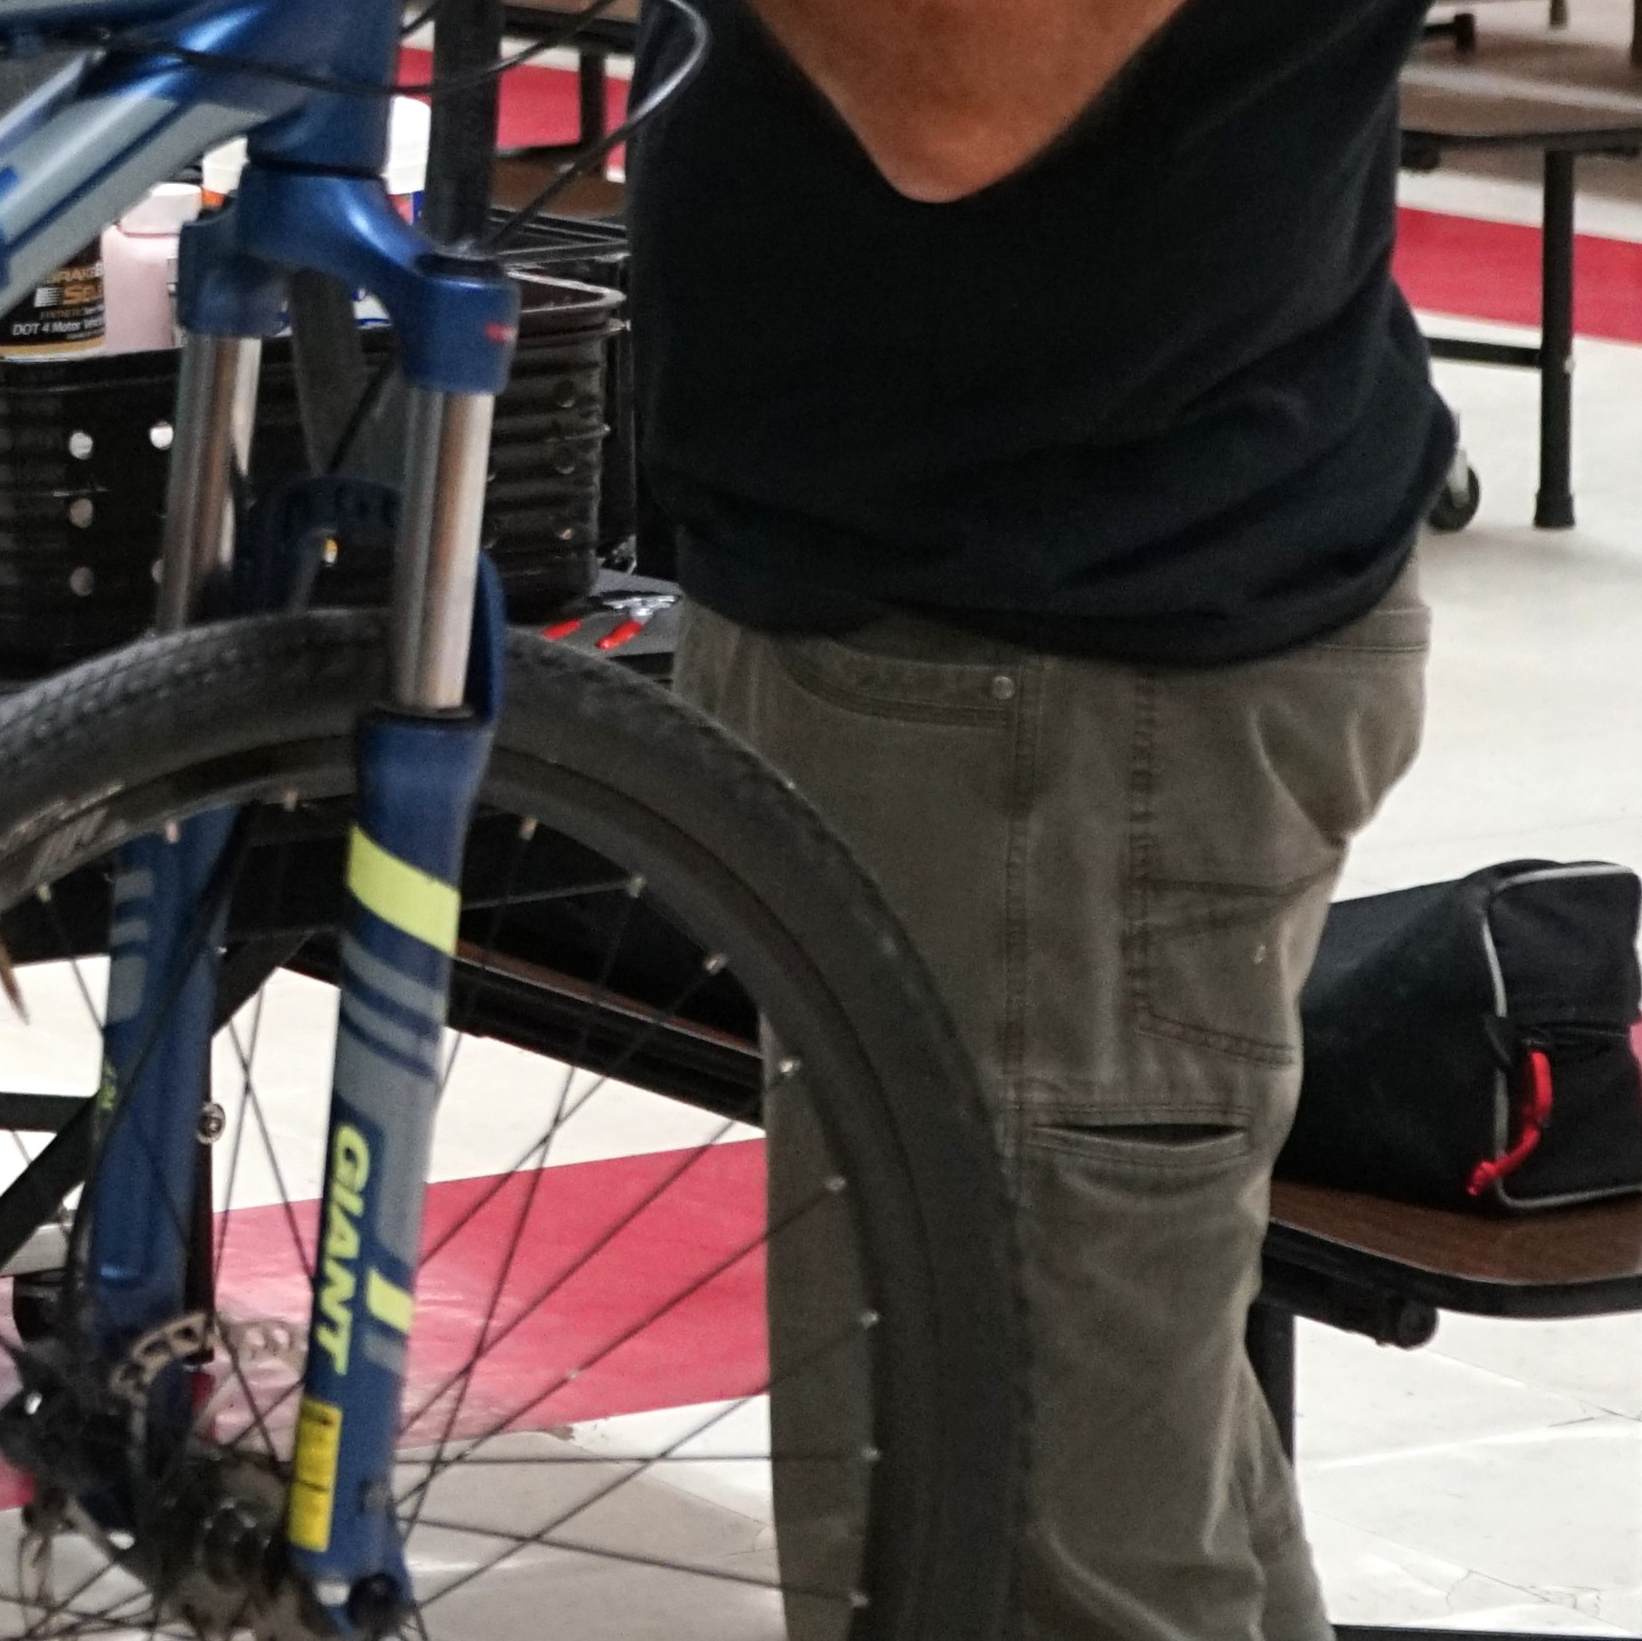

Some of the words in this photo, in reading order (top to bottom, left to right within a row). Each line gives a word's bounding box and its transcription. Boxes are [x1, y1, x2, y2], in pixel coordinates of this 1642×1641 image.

[12, 323, 40, 336] DOT
[41, 322, 50, 332] 4
[317, 1123, 370, 1376] GIANT
